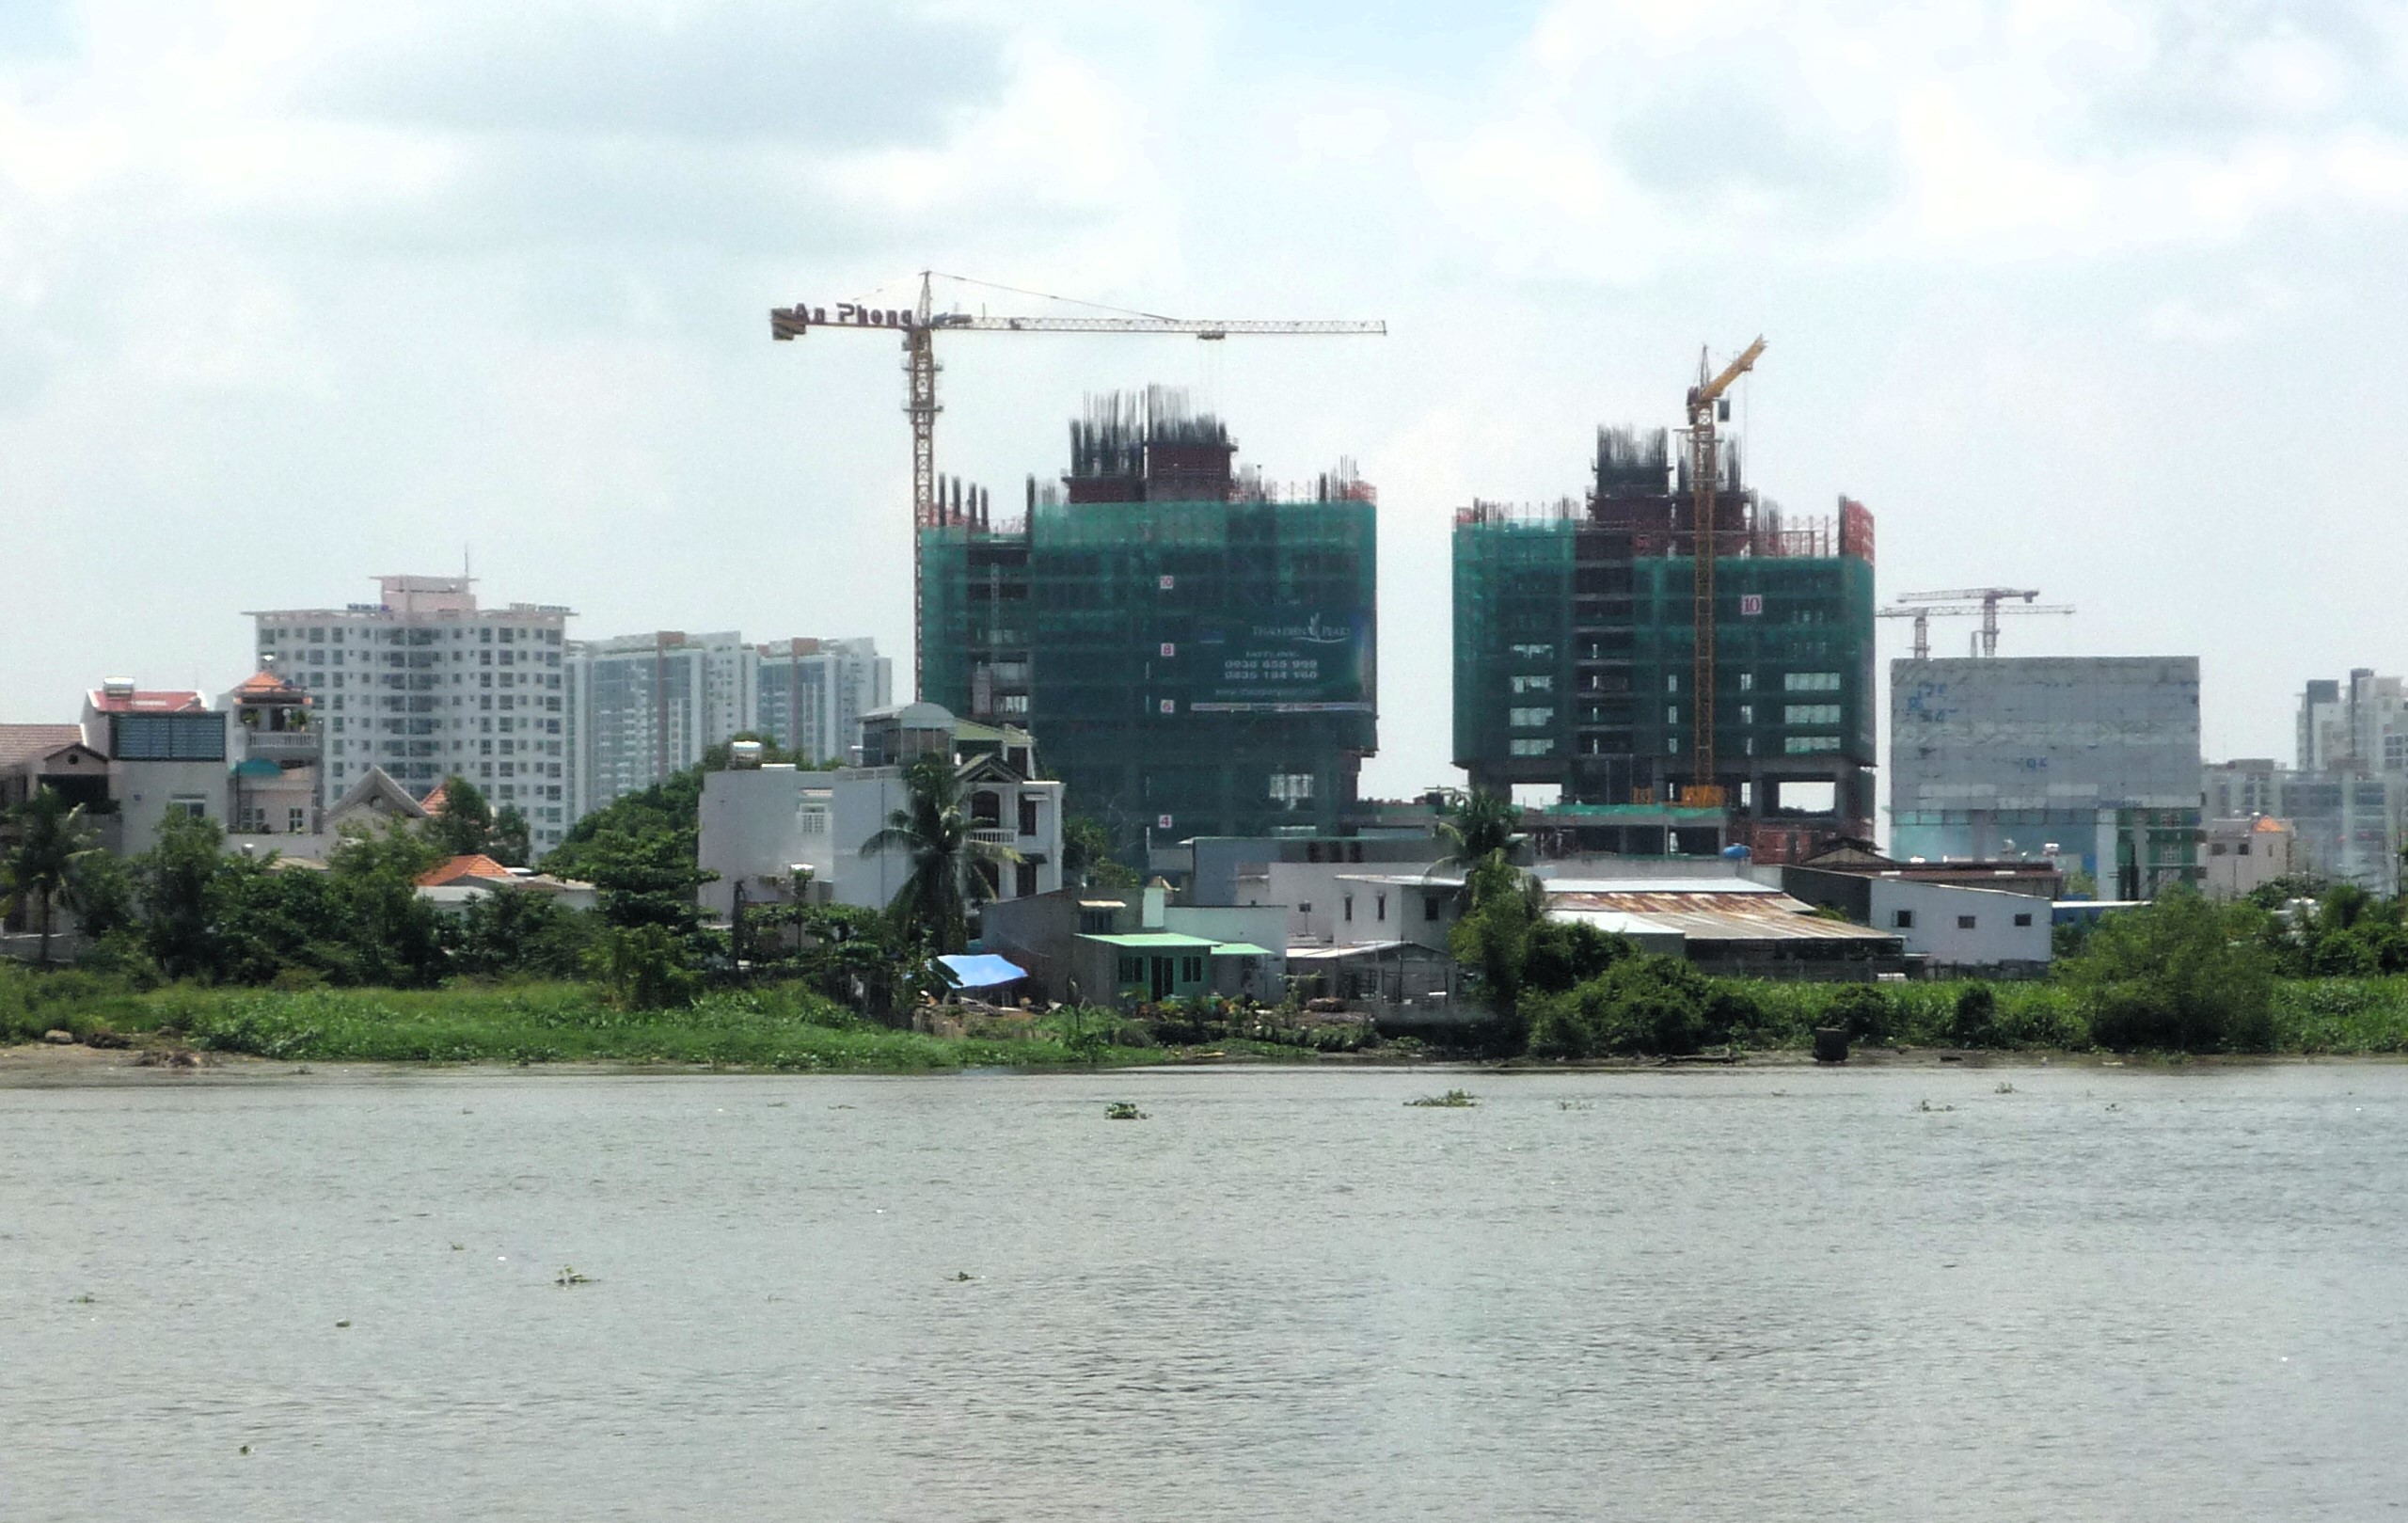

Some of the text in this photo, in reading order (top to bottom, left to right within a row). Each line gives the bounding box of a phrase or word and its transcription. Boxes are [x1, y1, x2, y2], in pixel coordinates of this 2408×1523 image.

[794, 302, 912, 325] An Phong
[1744, 596, 1760, 612] 10
